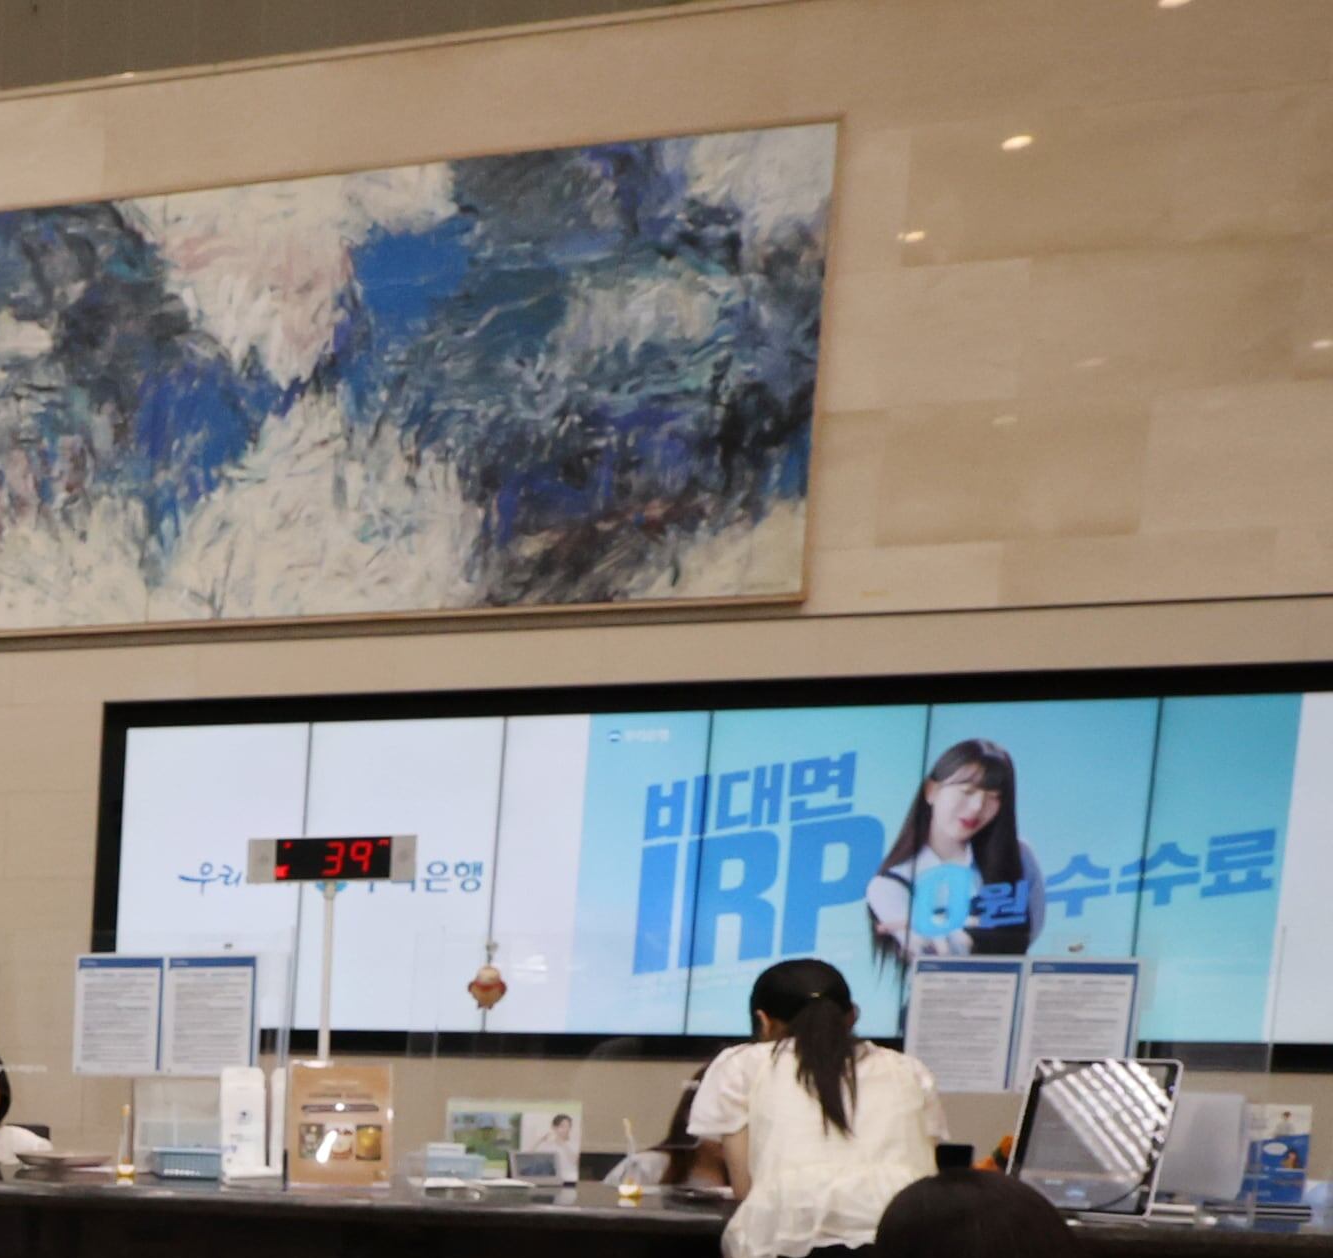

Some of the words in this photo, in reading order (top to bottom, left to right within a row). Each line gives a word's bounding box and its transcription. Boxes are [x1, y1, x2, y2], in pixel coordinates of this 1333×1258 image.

[644, 751, 857, 840] 비대면
[320, 840, 374, 877] 39
[630, 816, 885, 975] IRP
[1045, 828, 1276, 918] 수수료
